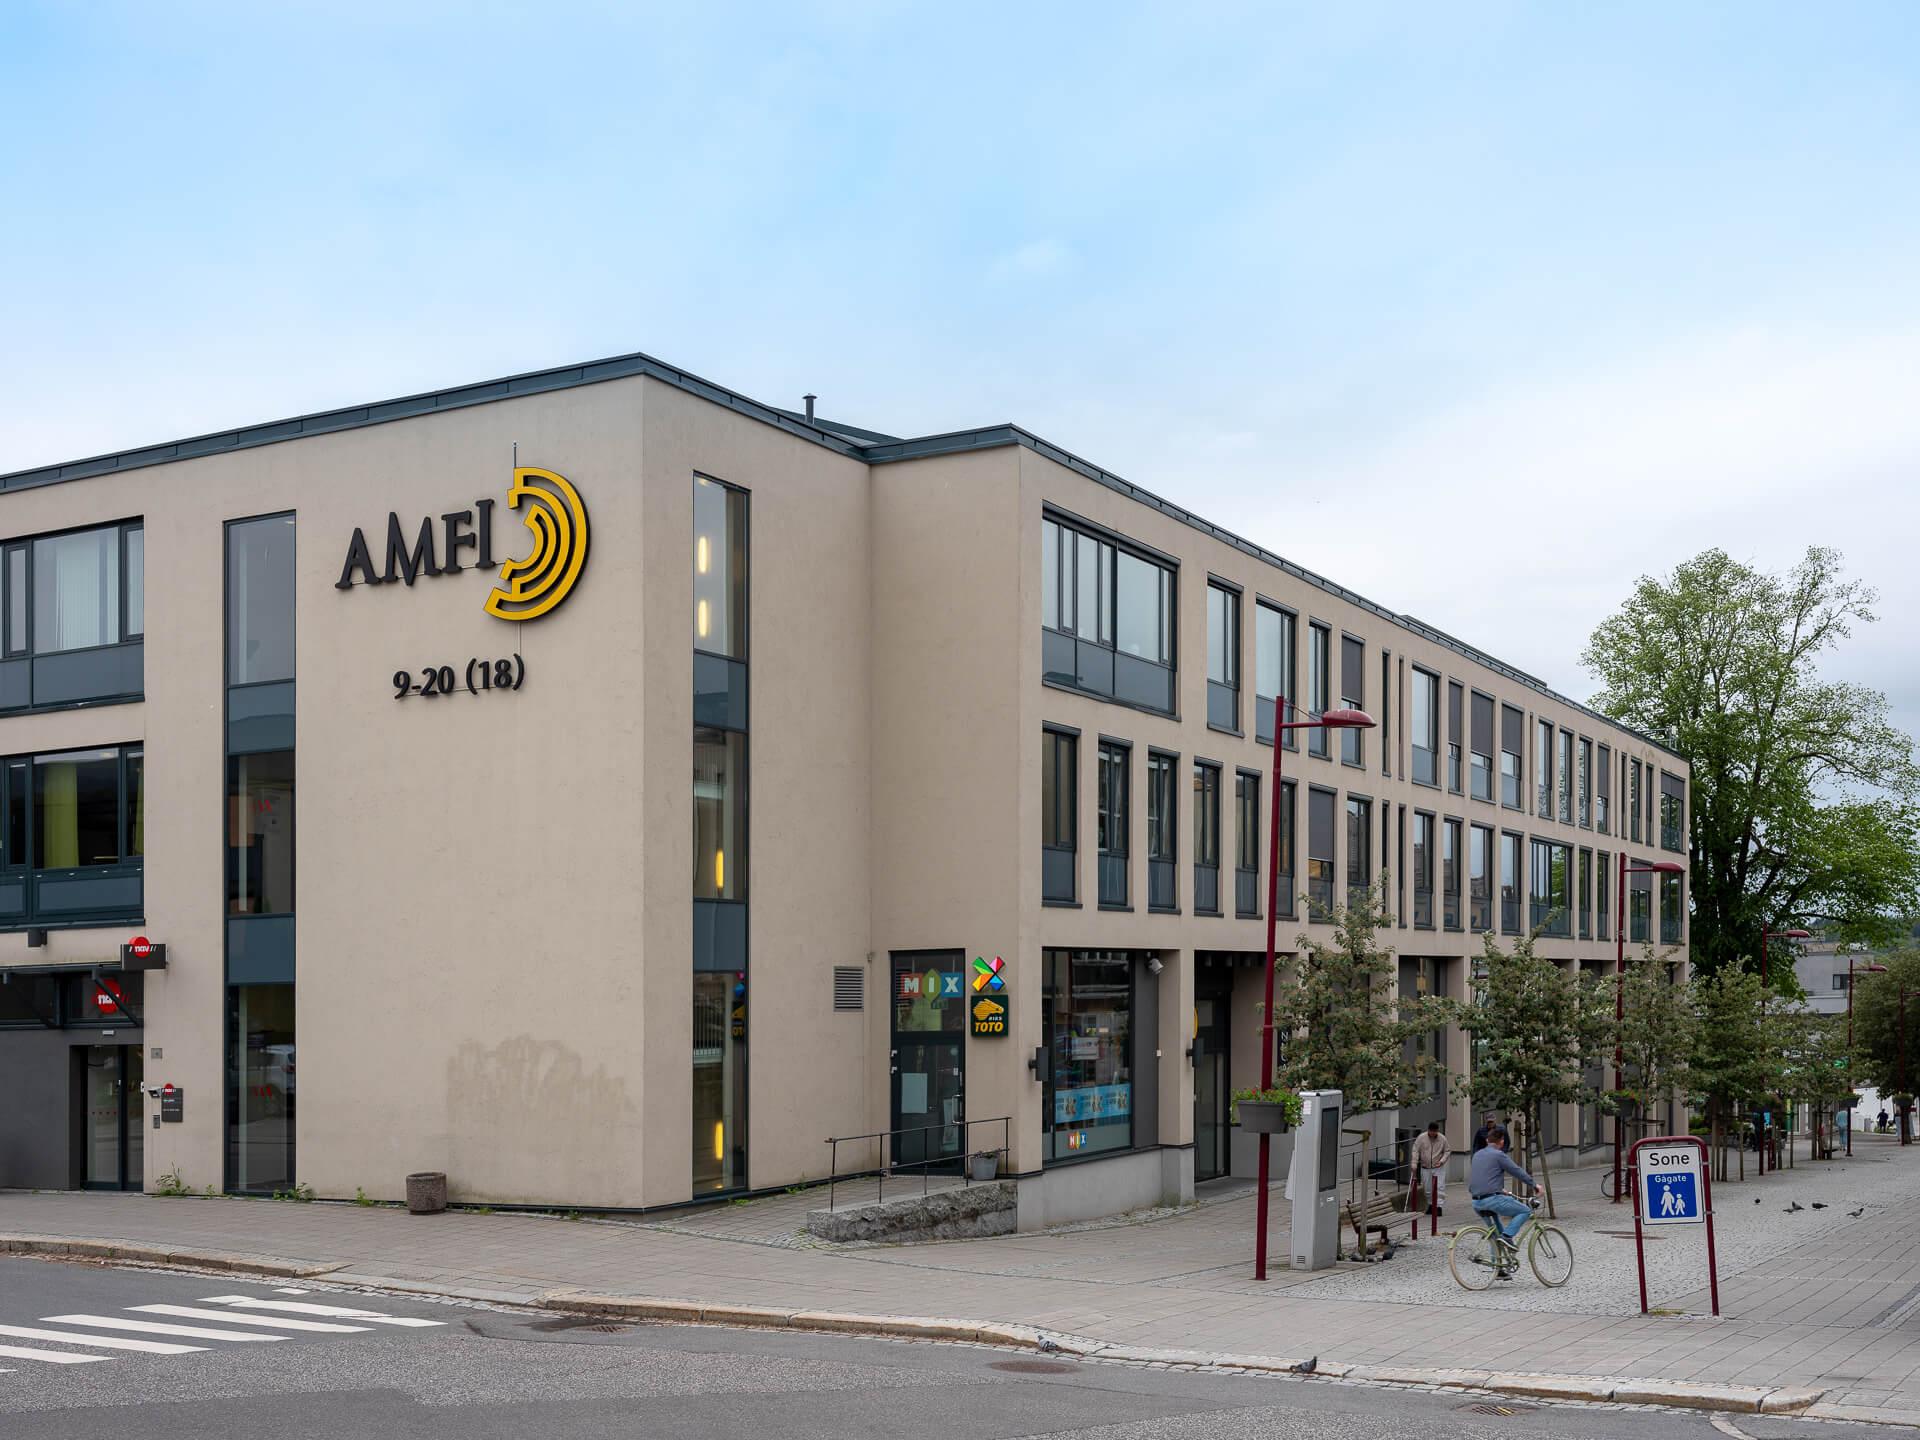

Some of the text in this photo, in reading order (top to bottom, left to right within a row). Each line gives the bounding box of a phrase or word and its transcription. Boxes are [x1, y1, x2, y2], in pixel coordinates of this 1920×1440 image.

[335, 499, 496, 589] AMFI
[393, 653, 525, 699] 9-20 (18)
[904, 977, 959, 993] MIX
[975, 1022, 1004, 1033] TOTO
[1650, 1152, 1690, 1166] Sone
[1655, 1175, 1687, 1184] Gågate
